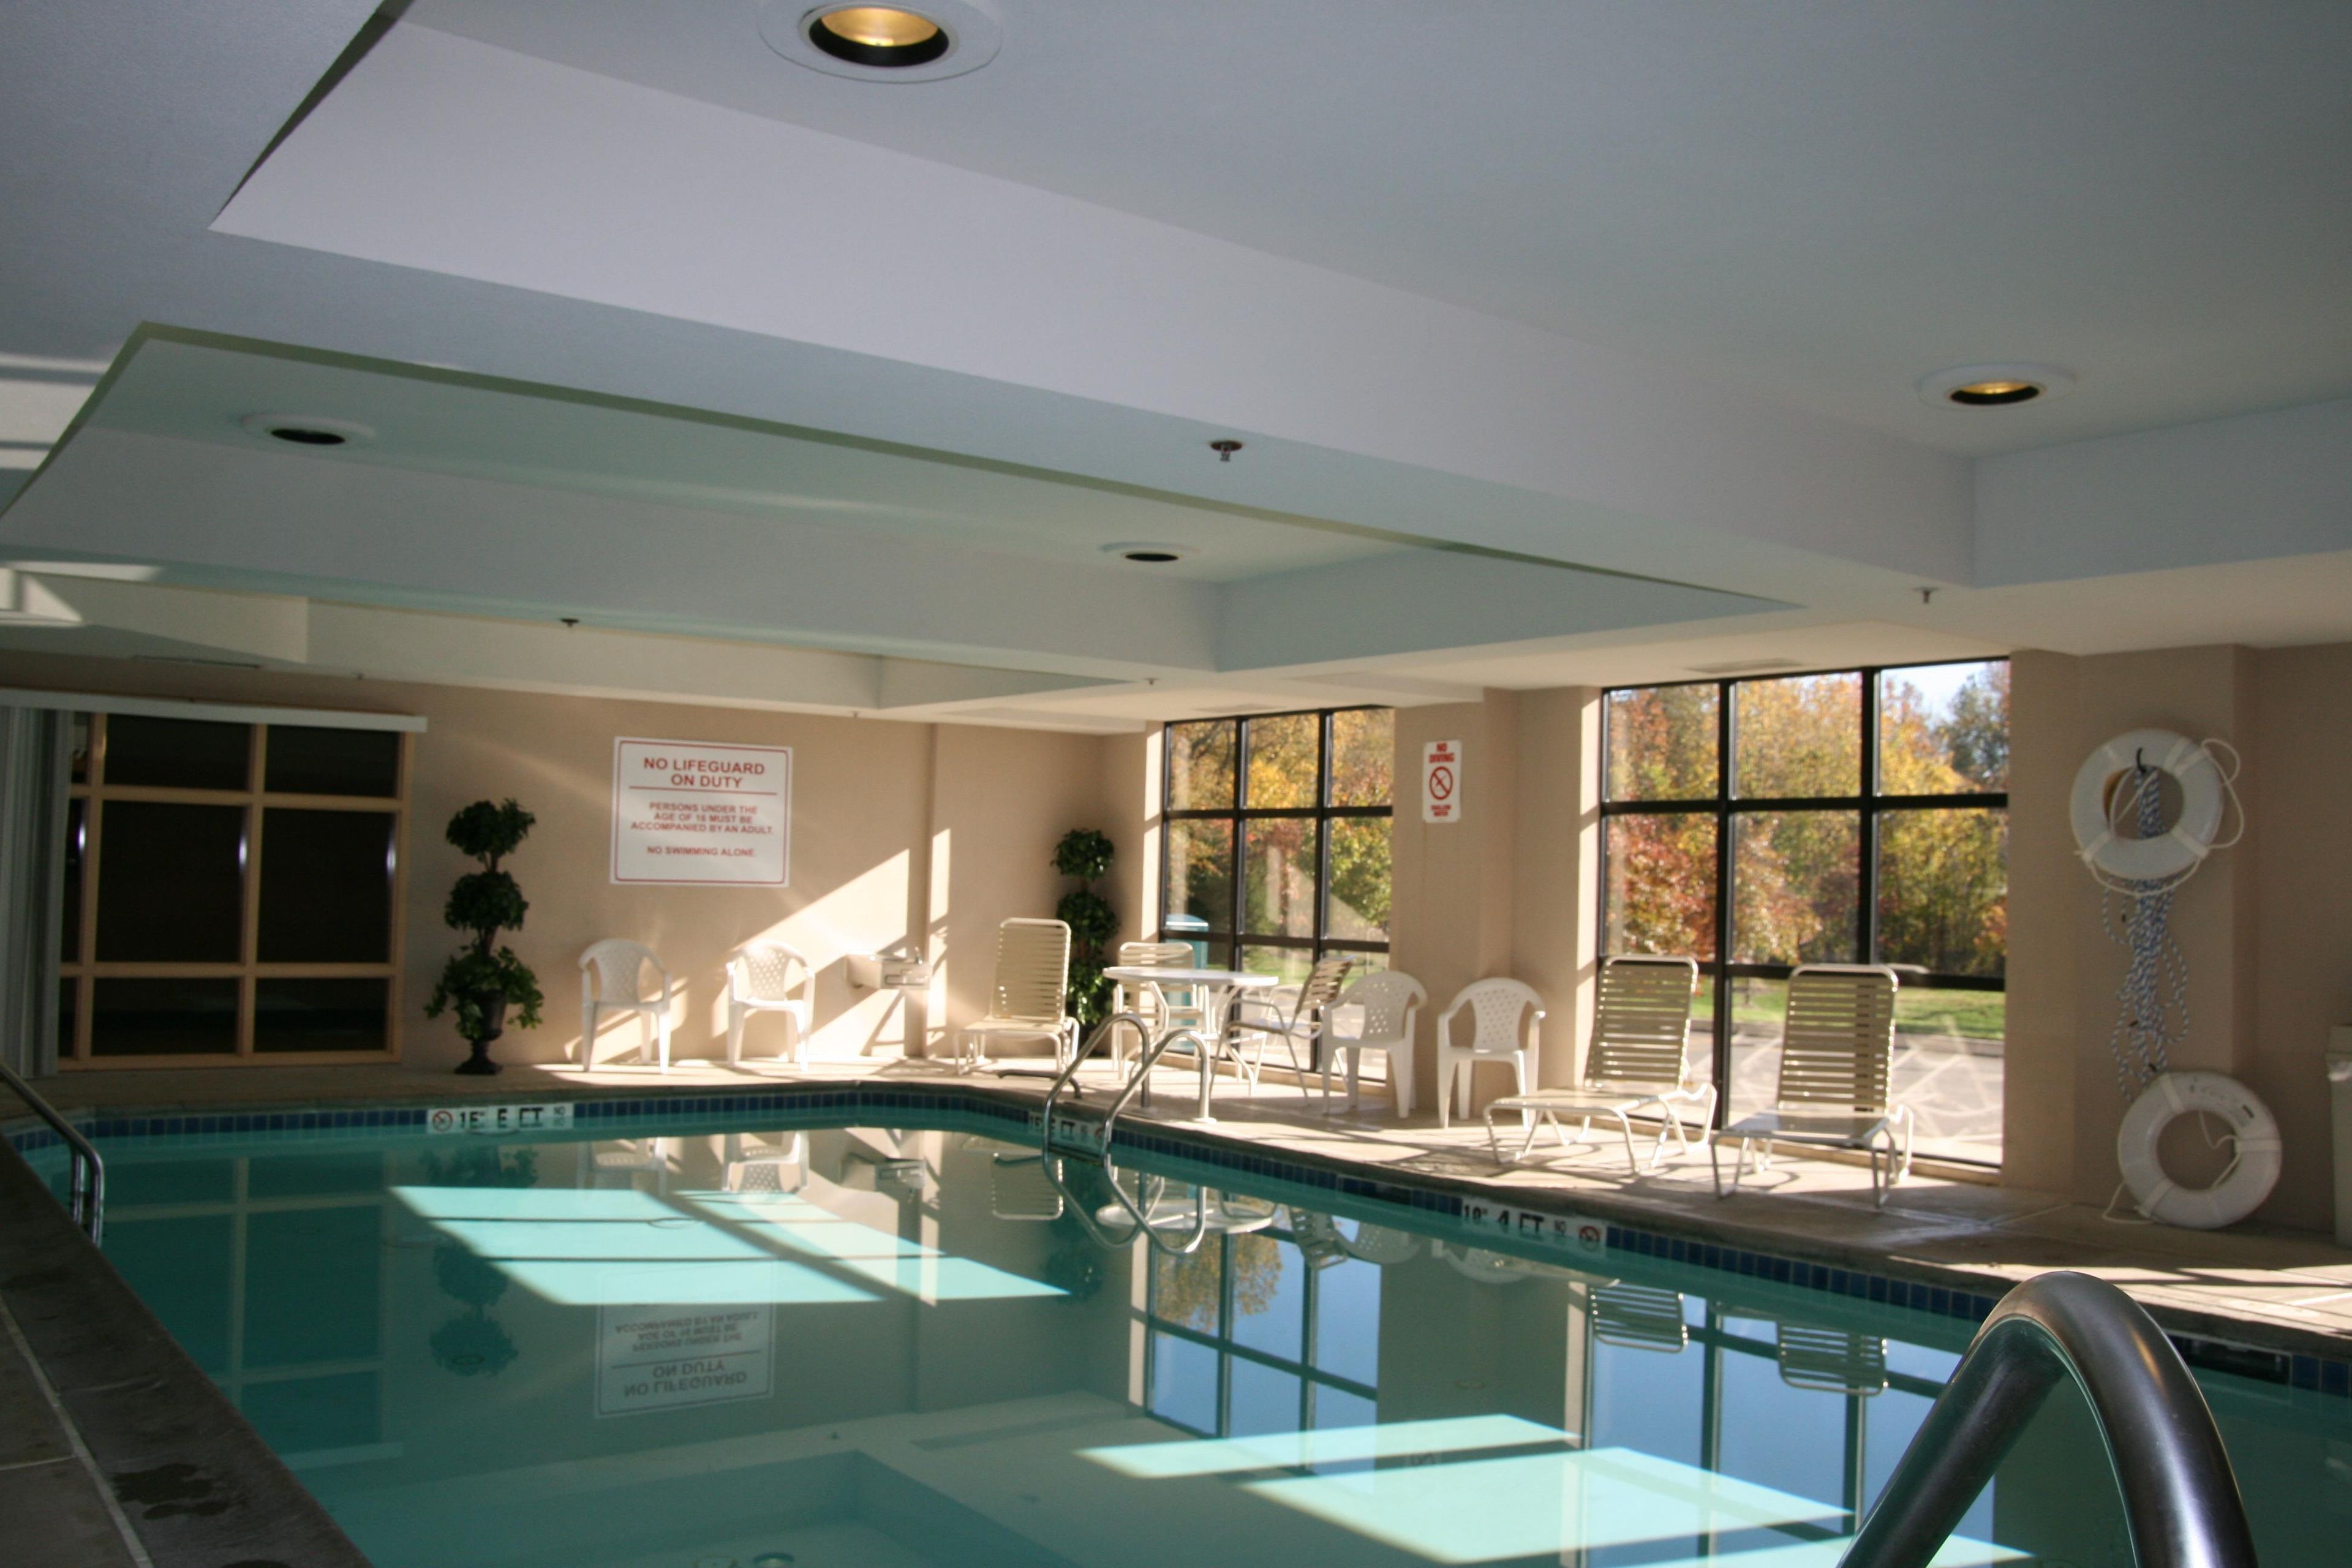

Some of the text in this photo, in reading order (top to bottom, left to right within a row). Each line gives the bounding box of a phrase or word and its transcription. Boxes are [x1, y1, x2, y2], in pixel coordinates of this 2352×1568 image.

[1436, 742, 1447, 752] NO
[1429, 753, 1455, 763] DIVING
[644, 757, 765, 775] NO LIFEGUARD
[671, 774, 743, 788] ON DUTY
[649, 802, 758, 814] PERSONS UNDER THE
[654, 812, 674, 821] AGE
[678, 813, 692, 821] OF
[709, 815, 736, 823] MUST
[739, 815, 753, 824] BE
[631, 821, 706, 832] ACCOMPANIED
[709, 824, 721, 832] BY
[725, 824, 738, 833] AN
[647, 846, 662, 854] NO
[666, 846, 718, 856] SWIMMING
